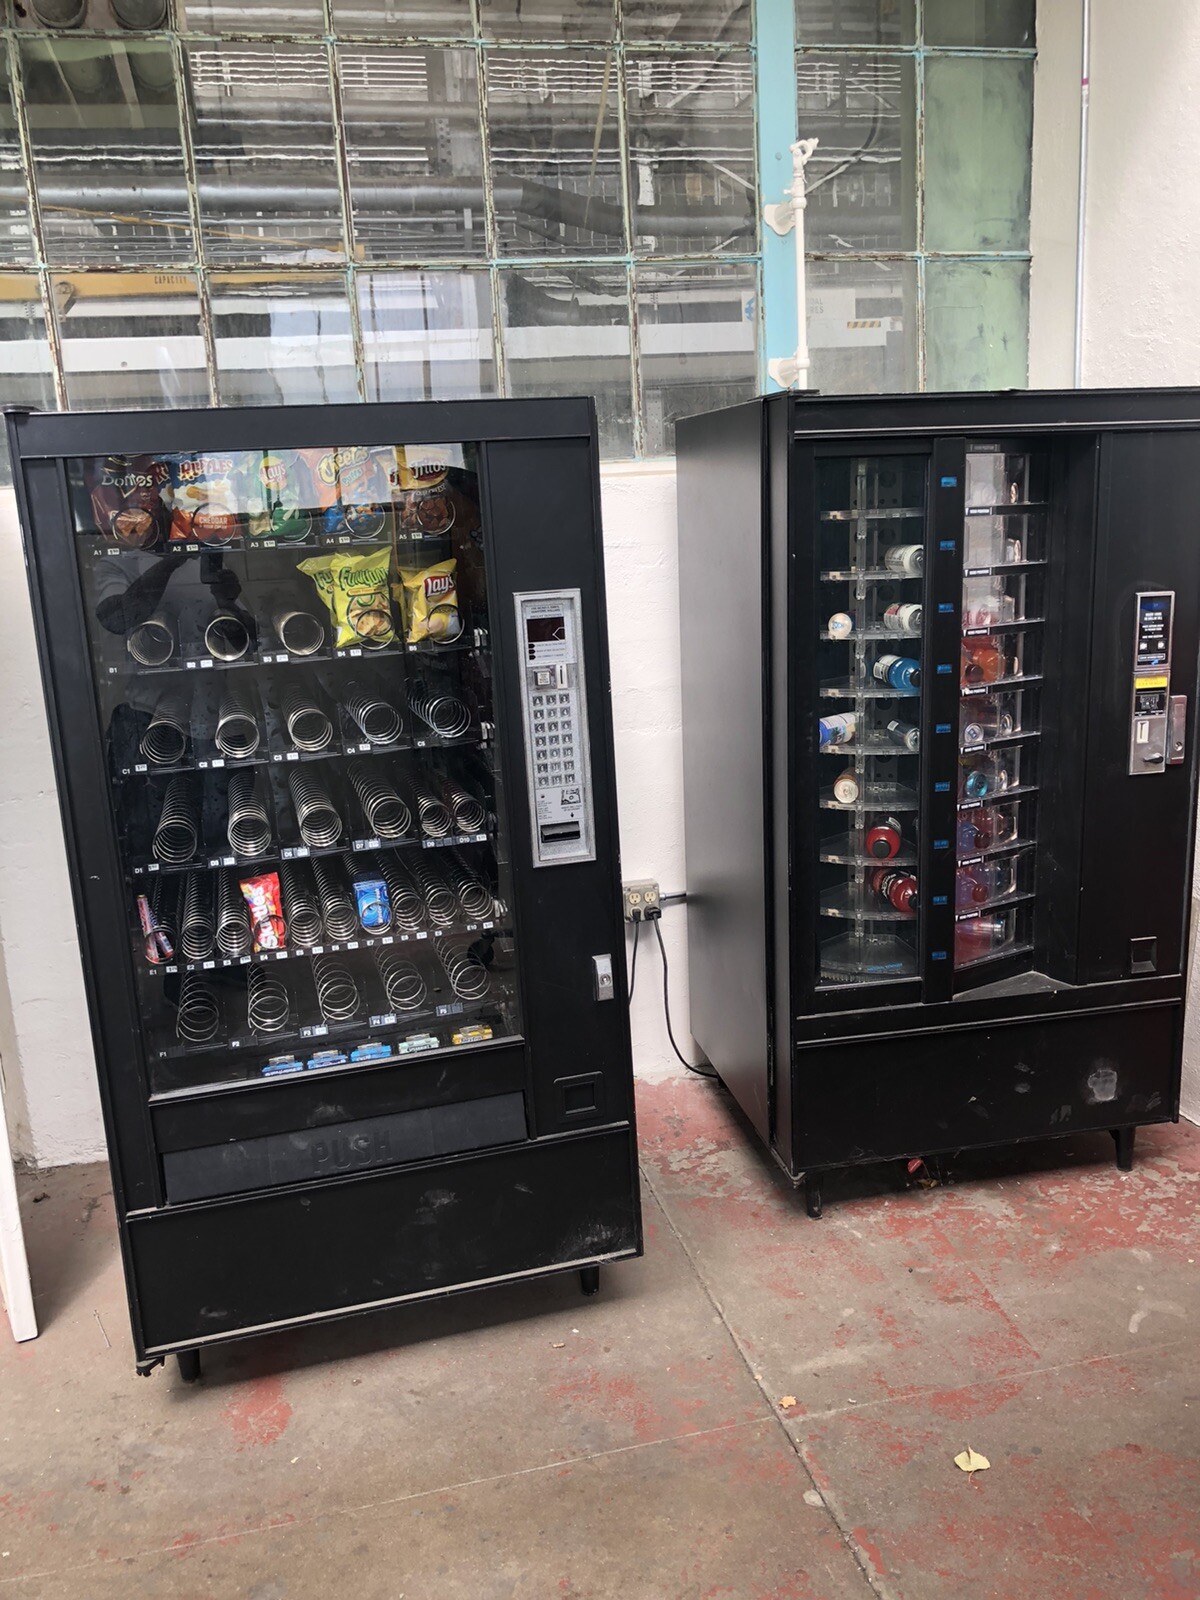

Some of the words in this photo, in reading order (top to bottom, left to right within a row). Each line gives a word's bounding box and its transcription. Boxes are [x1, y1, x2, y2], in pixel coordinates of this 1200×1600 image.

[154, 275, 187, 284] CAPACITY
[177, 458, 233, 480] RUFFLES
[410, 461, 447, 479] Fritos
[102, 472, 152, 487] Doritos
[427, 574, 455, 596] Lay's
